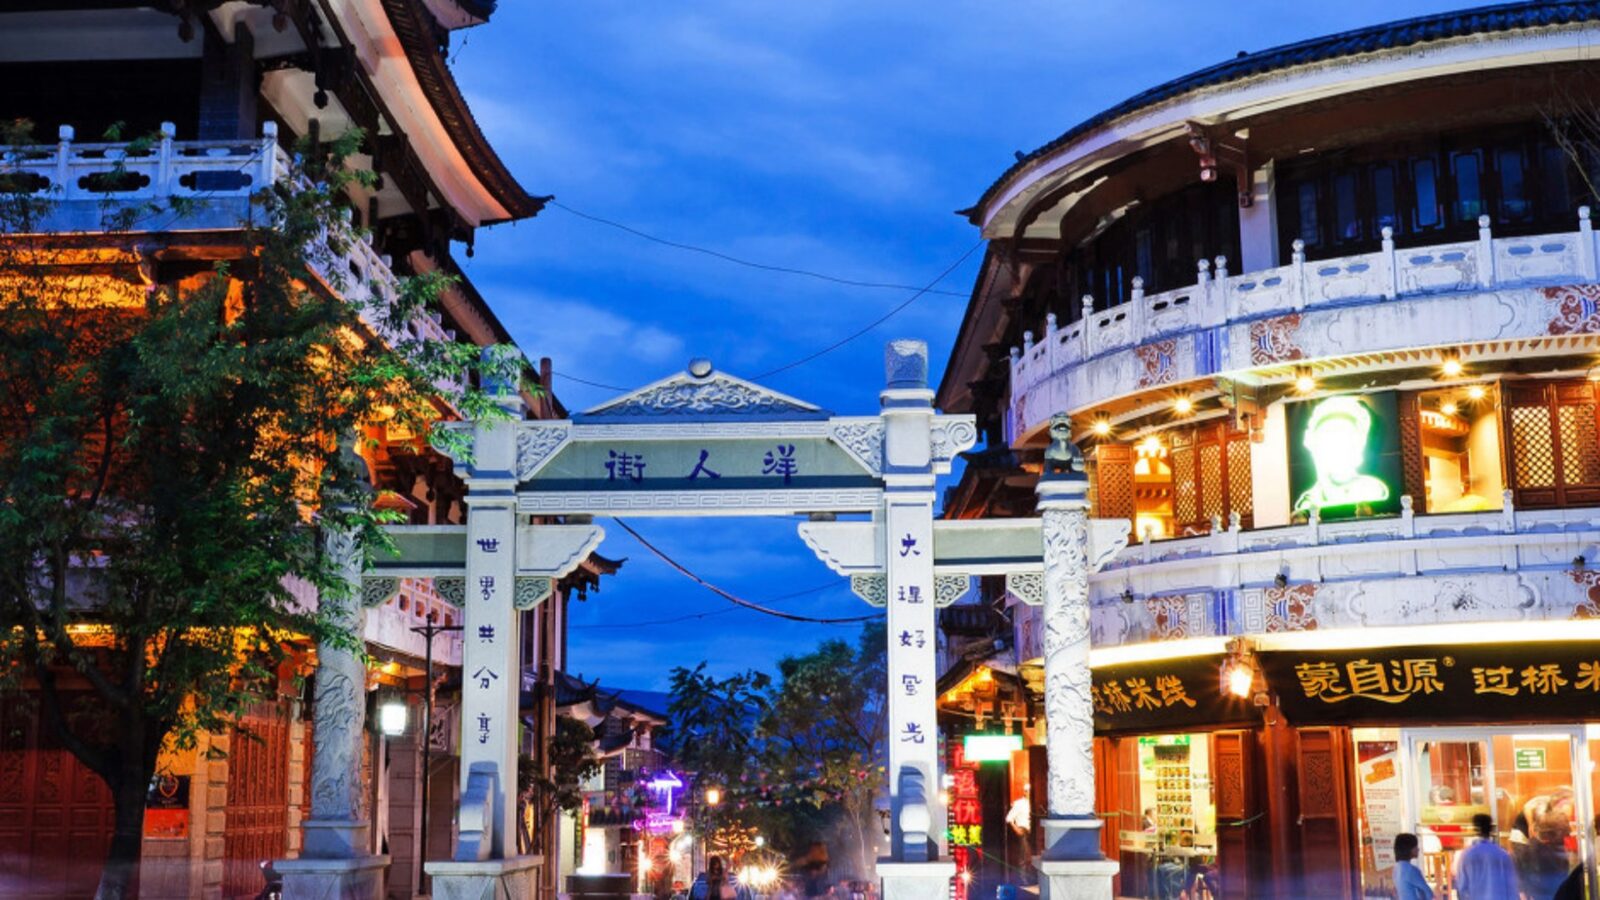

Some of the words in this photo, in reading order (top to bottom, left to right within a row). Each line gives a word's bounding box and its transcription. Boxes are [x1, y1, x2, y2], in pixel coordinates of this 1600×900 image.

[604, 443, 799, 486] 洋人街
[472, 538, 500, 744] 世界共分享
